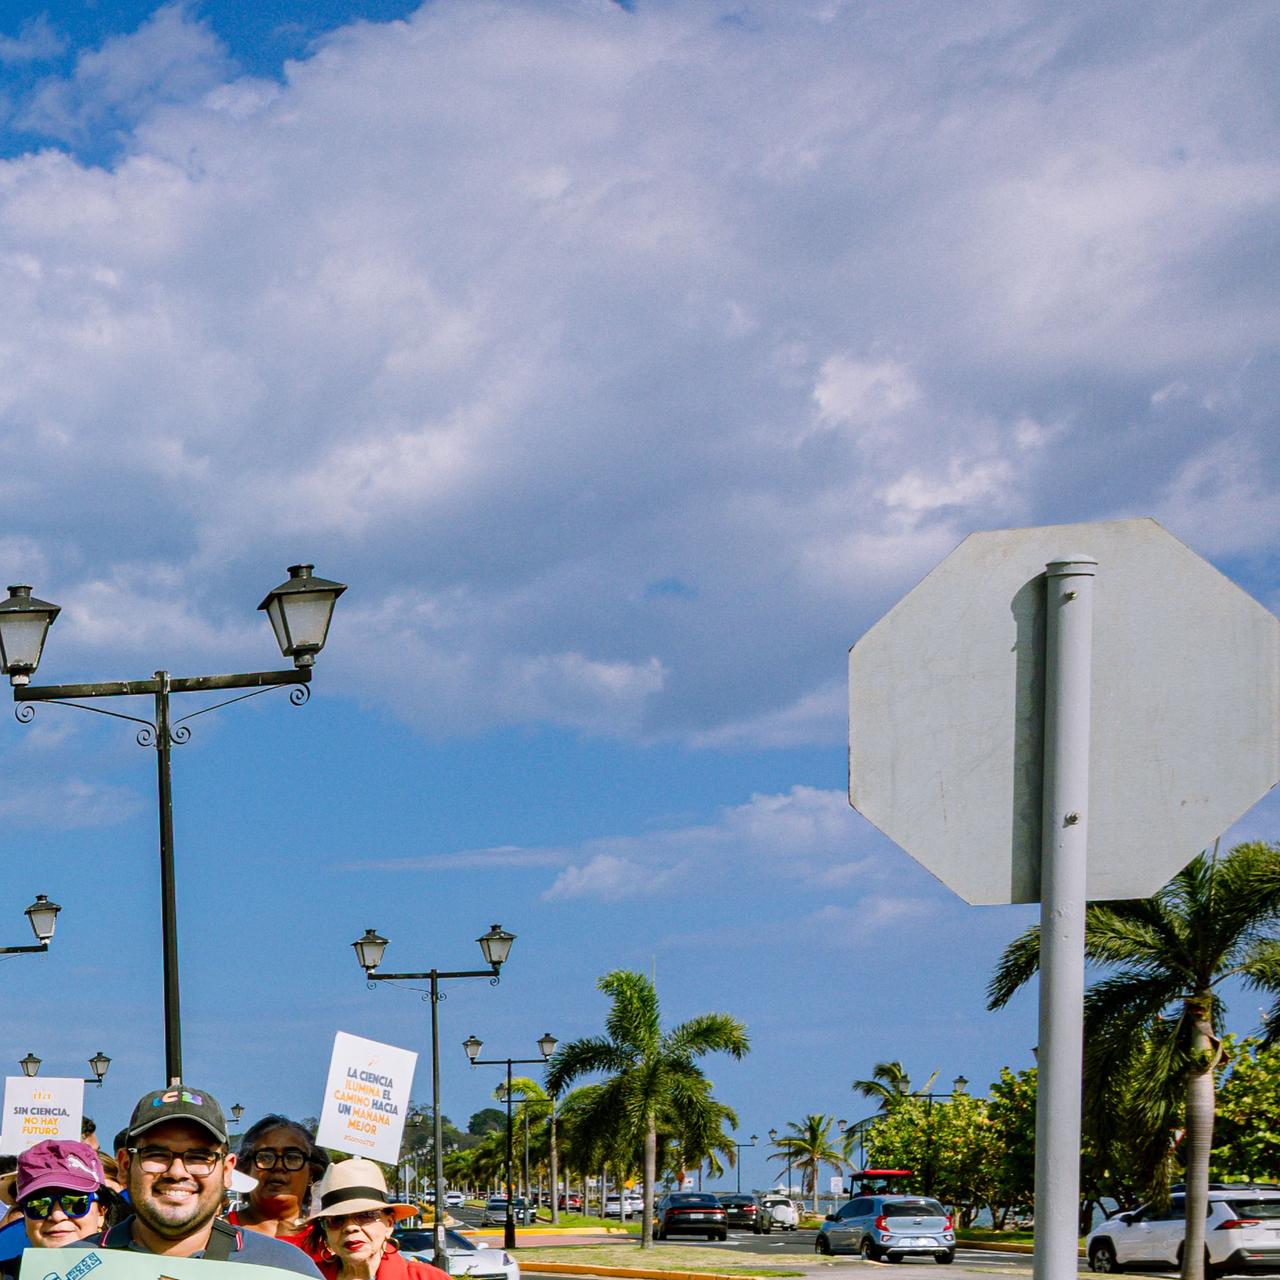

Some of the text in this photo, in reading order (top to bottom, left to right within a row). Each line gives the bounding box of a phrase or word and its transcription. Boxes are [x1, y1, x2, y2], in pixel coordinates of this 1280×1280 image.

[347, 1067, 393, 1088] LA CIENCIA
[345, 1080, 391, 1100] ILUMINA EL
[334, 1090, 398, 1115] CAMINO HACIA
[338, 1103, 352, 1115] UN
[14, 1106, 70, 1117] SIN CIENCIA,
[24, 1117, 58, 1126] NO HAY
[348, 1119, 377, 1135] MEJOR
[22, 1126, 59, 1135] FUTURO
